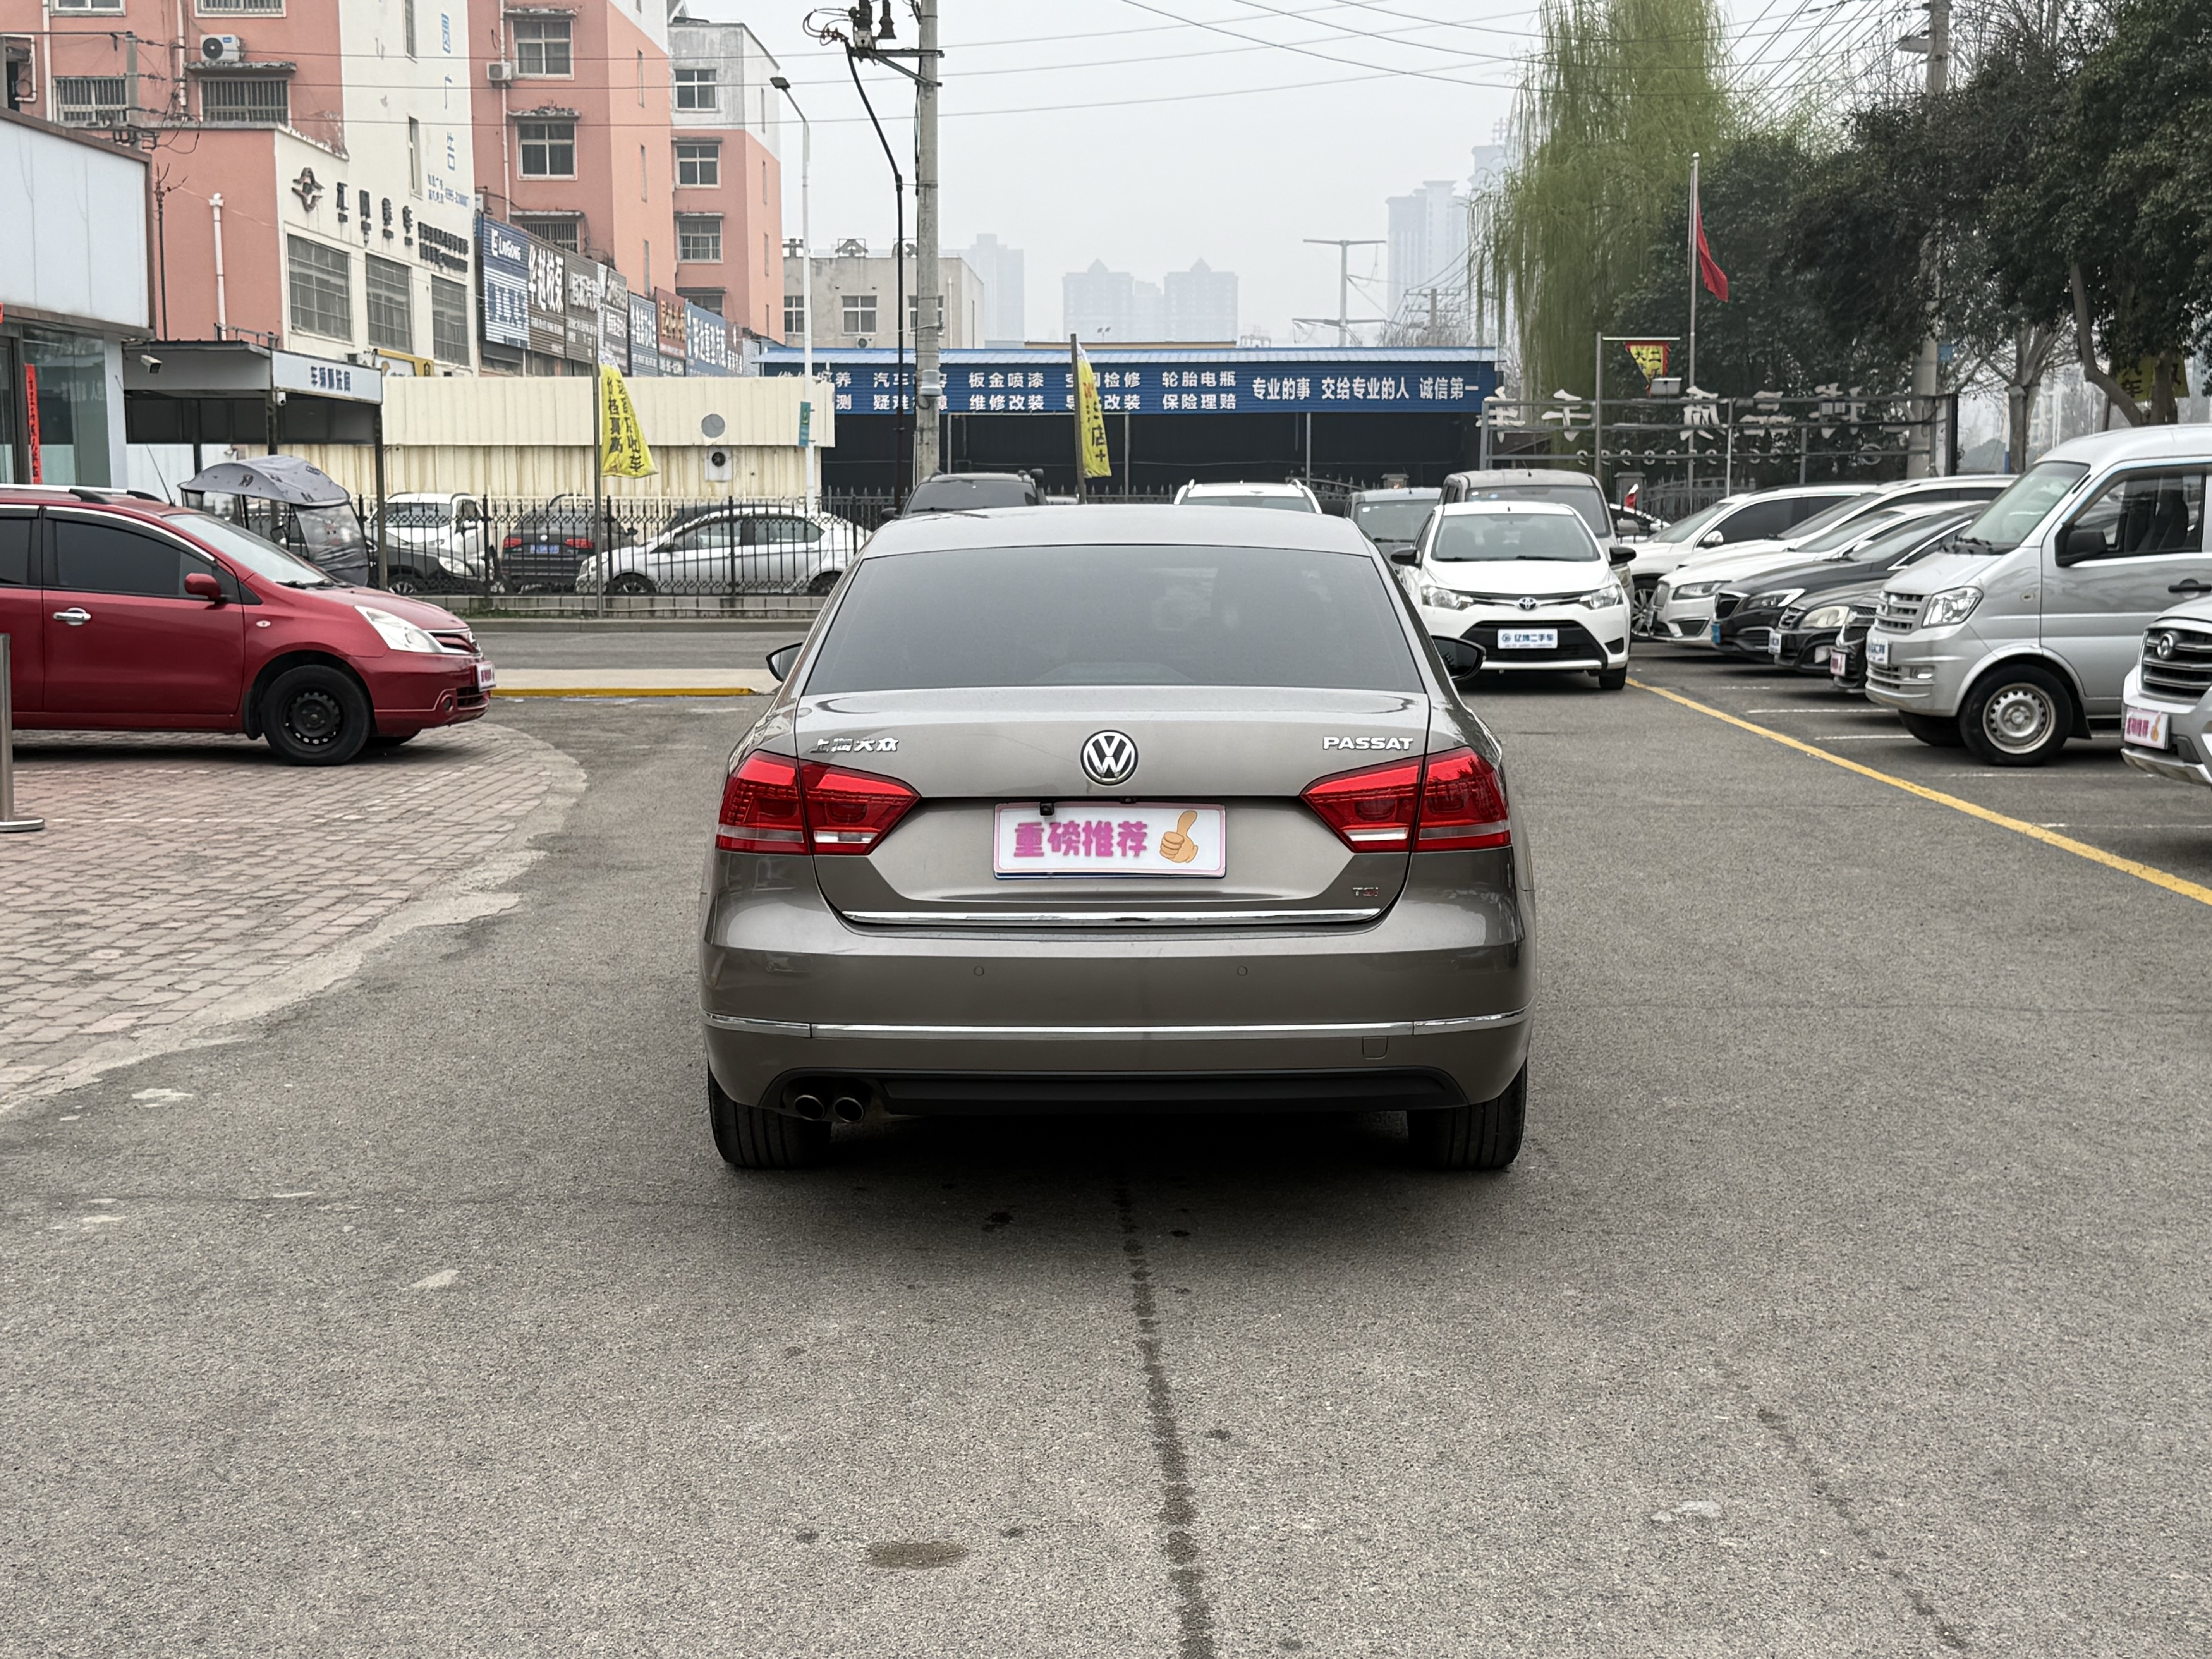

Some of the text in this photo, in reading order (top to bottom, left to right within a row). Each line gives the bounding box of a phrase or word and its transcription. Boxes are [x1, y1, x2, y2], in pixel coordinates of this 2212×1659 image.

[969, 372, 1044, 388] 板金喷漆
[1162, 371, 1236, 387] 轮胎电瓶
[1252, 377, 1310, 400] 专业的事
[1321, 376, 1410, 400] 交给专业的人
[1420, 376, 1479, 400] 诚信第一
[969, 394, 1044, 410] 维修改装
[1162, 393, 1236, 410] 保险理赔
[810, 738, 899, 753] 上海大众
[1323, 736, 1413, 750] PASSAT
[1014, 820, 1147, 857] 重磅推荐
